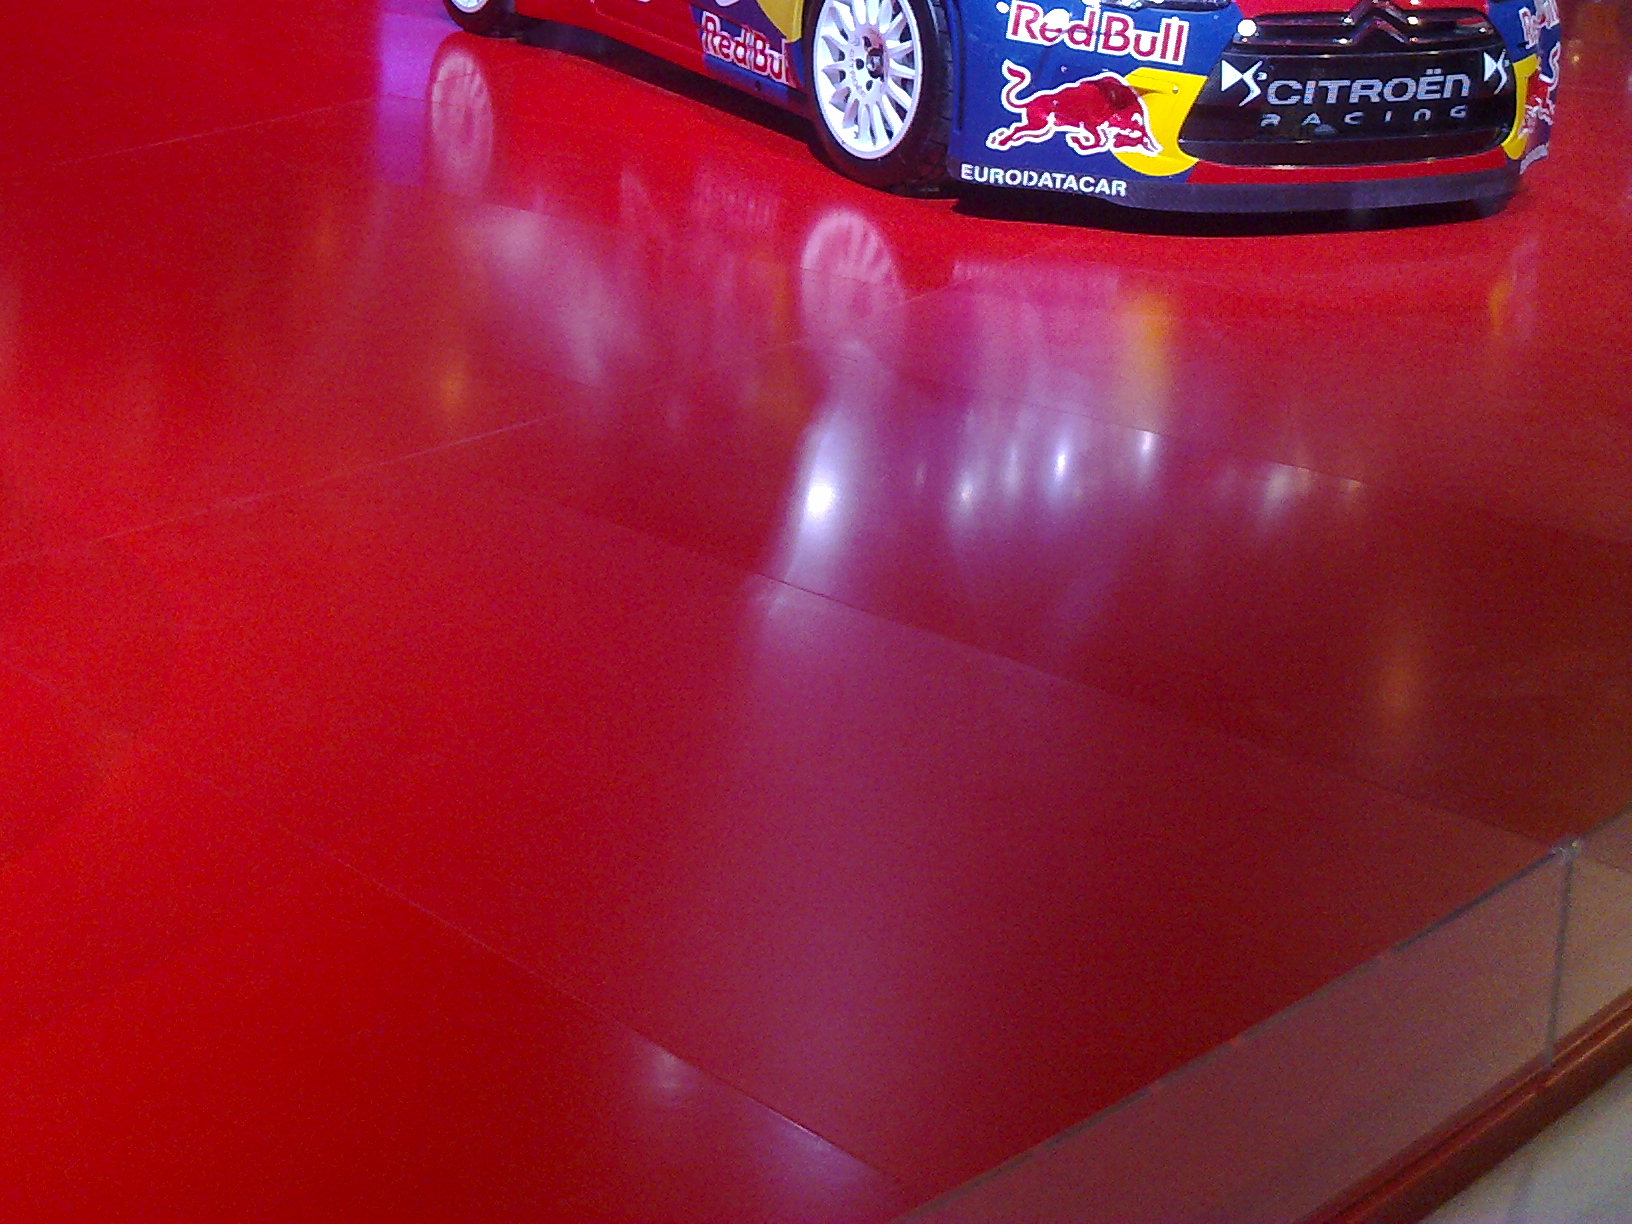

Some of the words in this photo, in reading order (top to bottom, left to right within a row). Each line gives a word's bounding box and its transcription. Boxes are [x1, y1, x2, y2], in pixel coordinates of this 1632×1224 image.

[702, 11, 752, 70] Red
[1008, 1, 1097, 52] Red
[1098, 12, 1189, 66] Bull
[1266, 68, 1470, 106] CITROËN
[1260, 105, 1467, 127] RACING
[960, 163, 1128, 197] EURODATACAR
